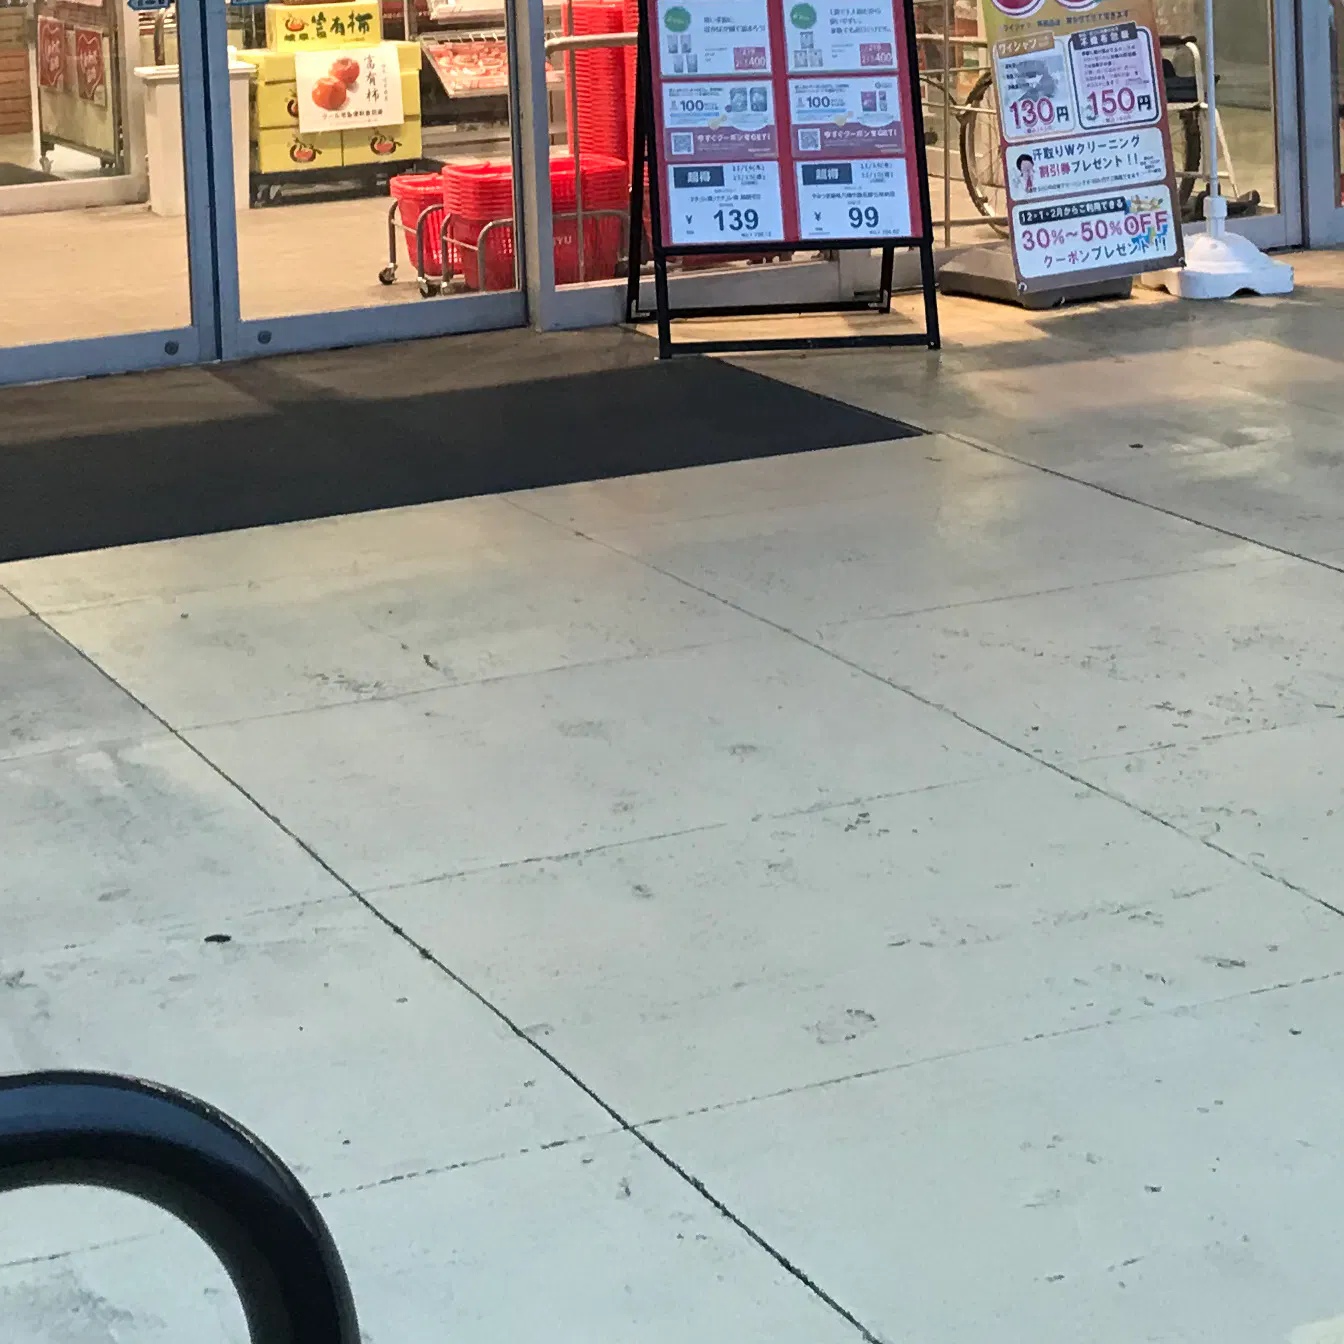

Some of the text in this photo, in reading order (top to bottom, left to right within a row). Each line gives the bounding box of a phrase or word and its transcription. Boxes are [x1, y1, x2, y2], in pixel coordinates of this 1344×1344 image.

[680, 99, 705, 112] 100
[806, 95, 831, 108] 100
[1009, 97, 1070, 129] 130円
[1086, 87, 1151, 119] 150円
[1032, 134, 1140, 161] 汗取りWクリーニング
[713, 208, 760, 232] 139
[848, 206, 880, 229] 99
